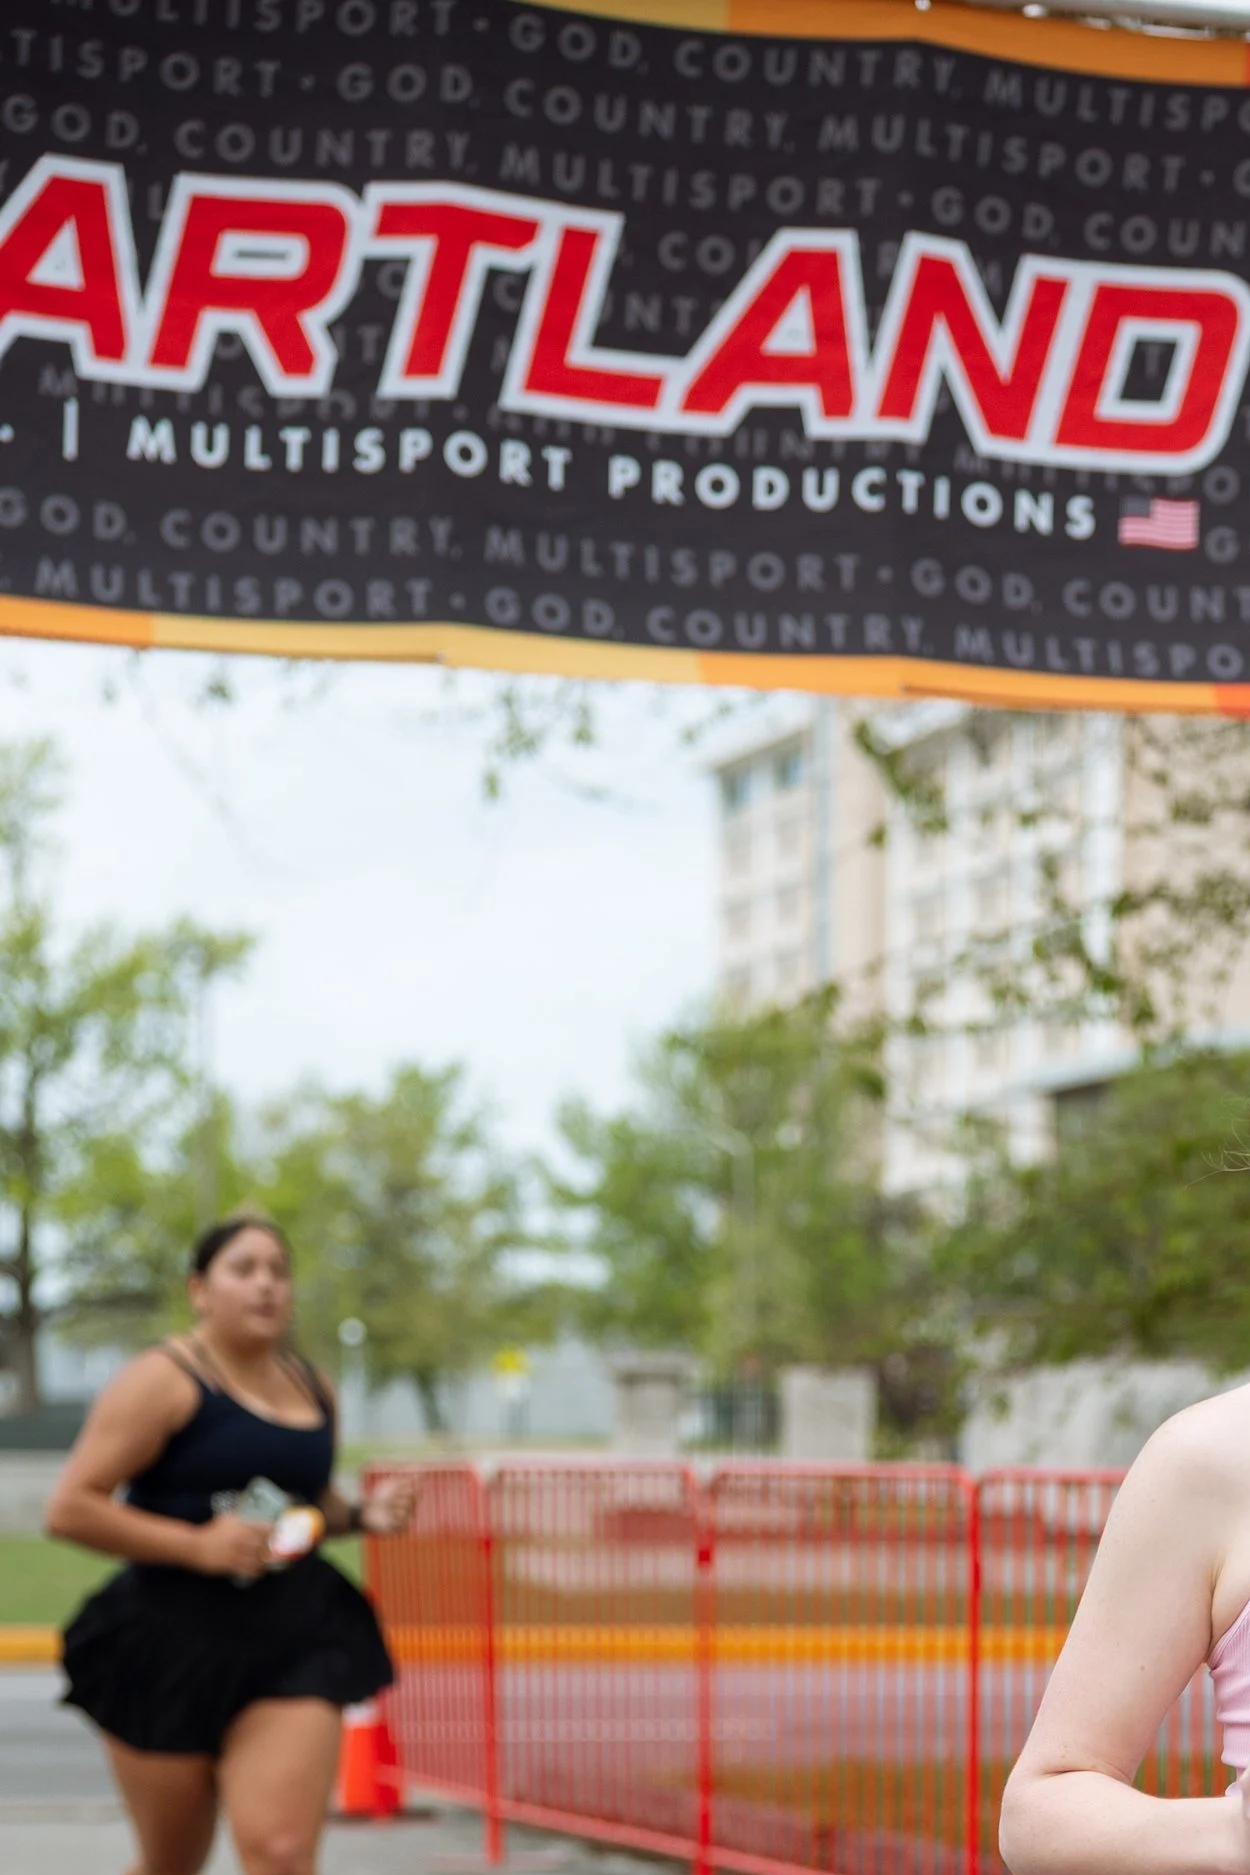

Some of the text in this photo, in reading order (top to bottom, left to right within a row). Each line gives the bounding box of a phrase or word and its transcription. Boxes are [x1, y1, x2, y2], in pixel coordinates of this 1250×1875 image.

[8, 26, 282, 98] TISPORT
[817, 114, 1184, 193] MULTISPORT
[499, 142, 884, 217] MULTISPORT
[126, 415, 573, 491] MULTISPORT
[607, 454, 1097, 541] PRODUCTIONS
[35, 556, 432, 618] MULTISPORT
[484, 526, 859, 592] MULTISPORT
